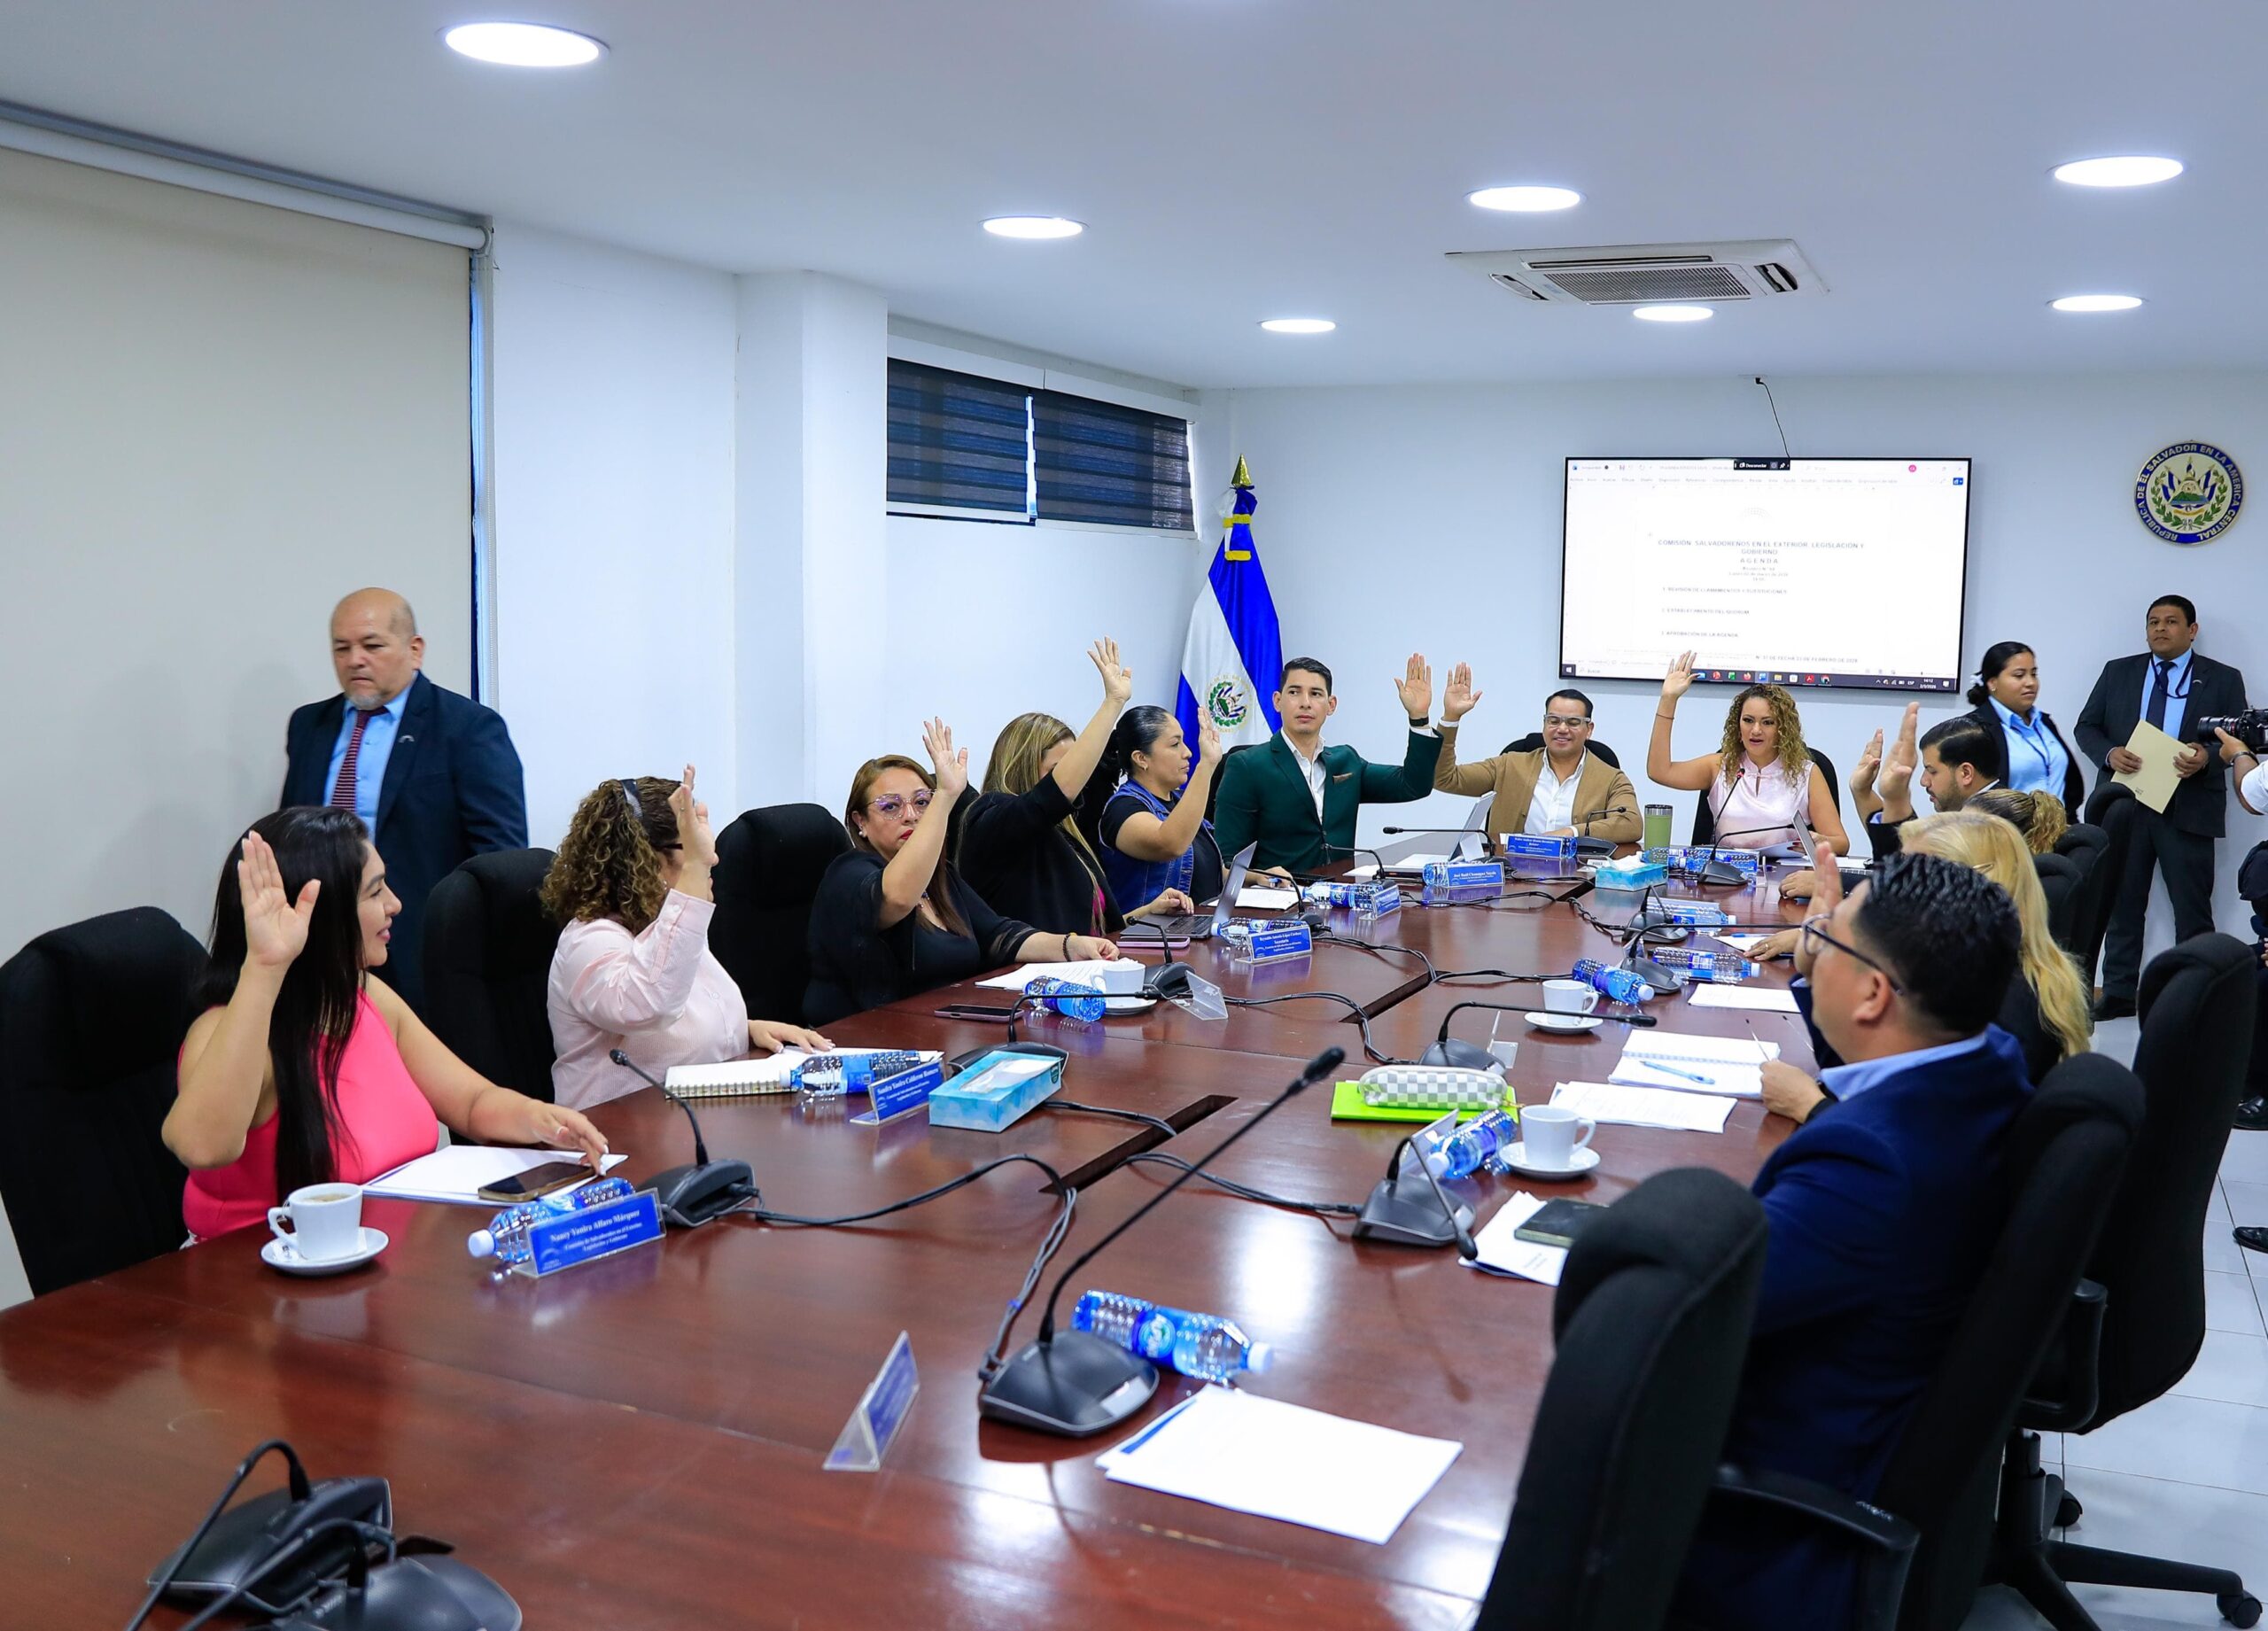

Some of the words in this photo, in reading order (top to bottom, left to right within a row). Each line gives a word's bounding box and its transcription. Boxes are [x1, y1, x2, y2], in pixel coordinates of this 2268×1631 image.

[2148, 444, 2197, 471] SALVADOR
[2200, 445, 2214, 455] EN
[2215, 452, 2226, 463] LA
[2139, 470, 2149, 483] EL
[2225, 463, 2241, 507] AMERICA
[2137, 484, 2145, 498] DE
[2138, 502, 2178, 541] REPUBLICA
[2197, 510, 2236, 540] CENTRAL
[550, 1232, 571, 1243] Nancy
[594, 1219, 612, 1230] Alfaro
